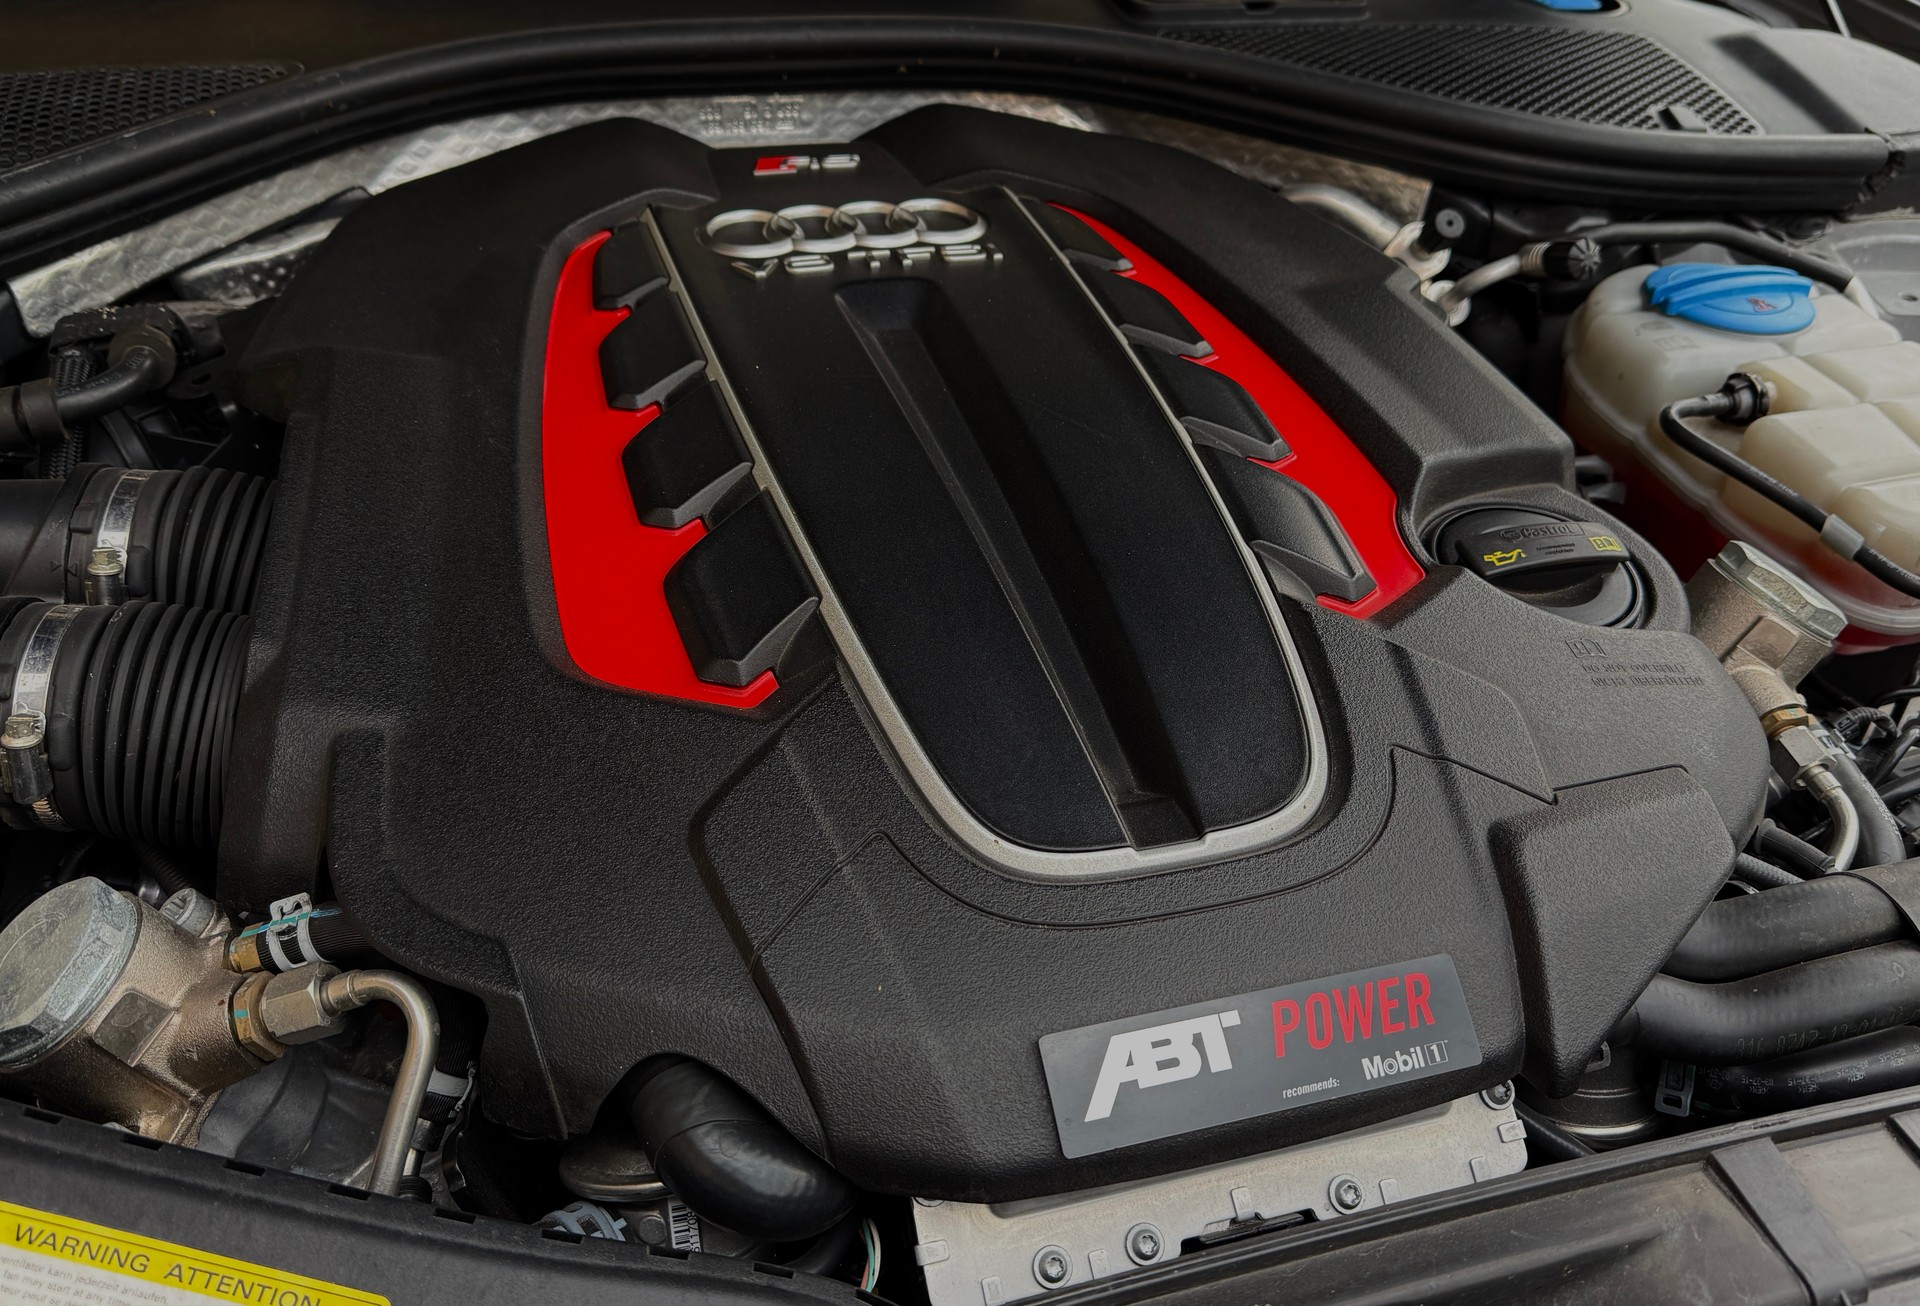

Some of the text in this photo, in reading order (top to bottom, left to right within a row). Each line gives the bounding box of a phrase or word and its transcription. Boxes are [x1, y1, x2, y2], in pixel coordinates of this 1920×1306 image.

[1521, 522, 1574, 538] Castrol
[1582, 664, 1600, 674] DO
[1602, 663, 1627, 673] NOT
[1084, 972, 1436, 1123] ABT POWER
[1282, 1077, 1341, 1099] recommends:
[1361, 1046, 1425, 1080] Mobil
[15, 1223, 151, 1273] WARNING
[3, 1268, 20, 1281] fan
[22, 1275, 44, 1289] may
[47, 1281, 72, 1295] start
